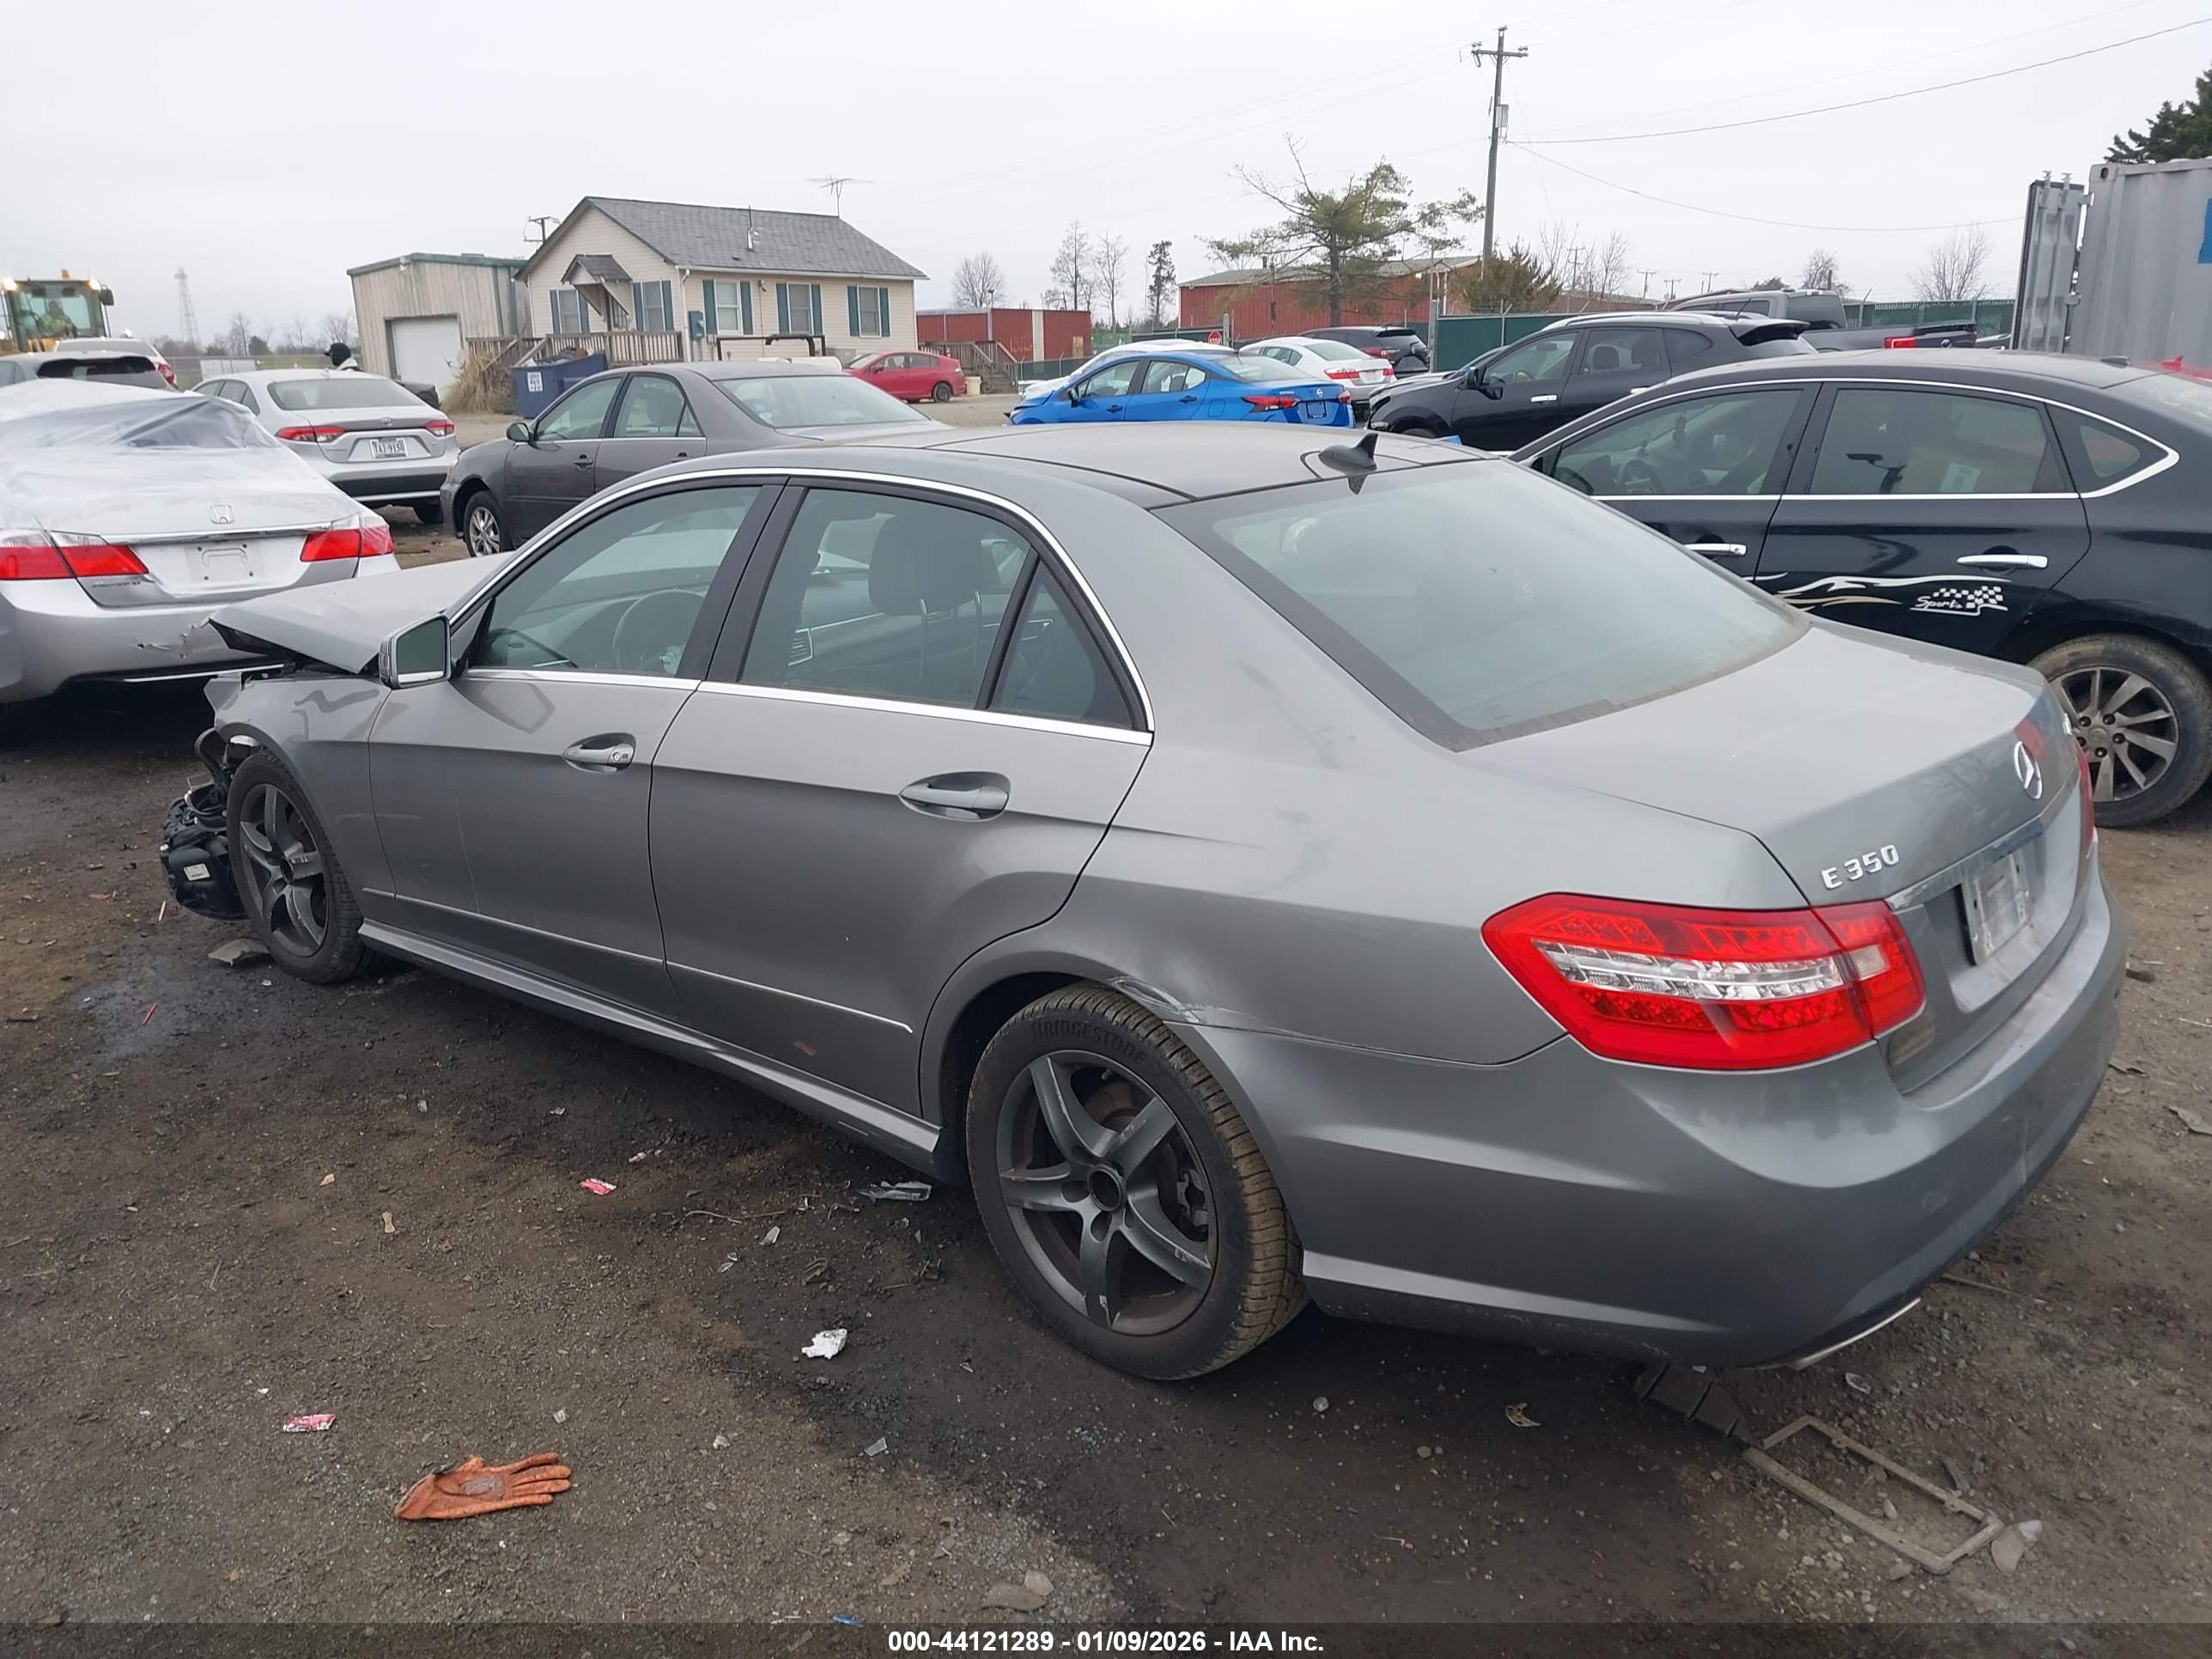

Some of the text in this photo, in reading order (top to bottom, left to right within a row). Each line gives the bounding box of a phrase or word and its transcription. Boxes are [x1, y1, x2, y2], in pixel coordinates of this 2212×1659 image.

[1821, 844, 1900, 889] E 350
[1031, 1018, 1147, 1066] BRIDGESTONE
